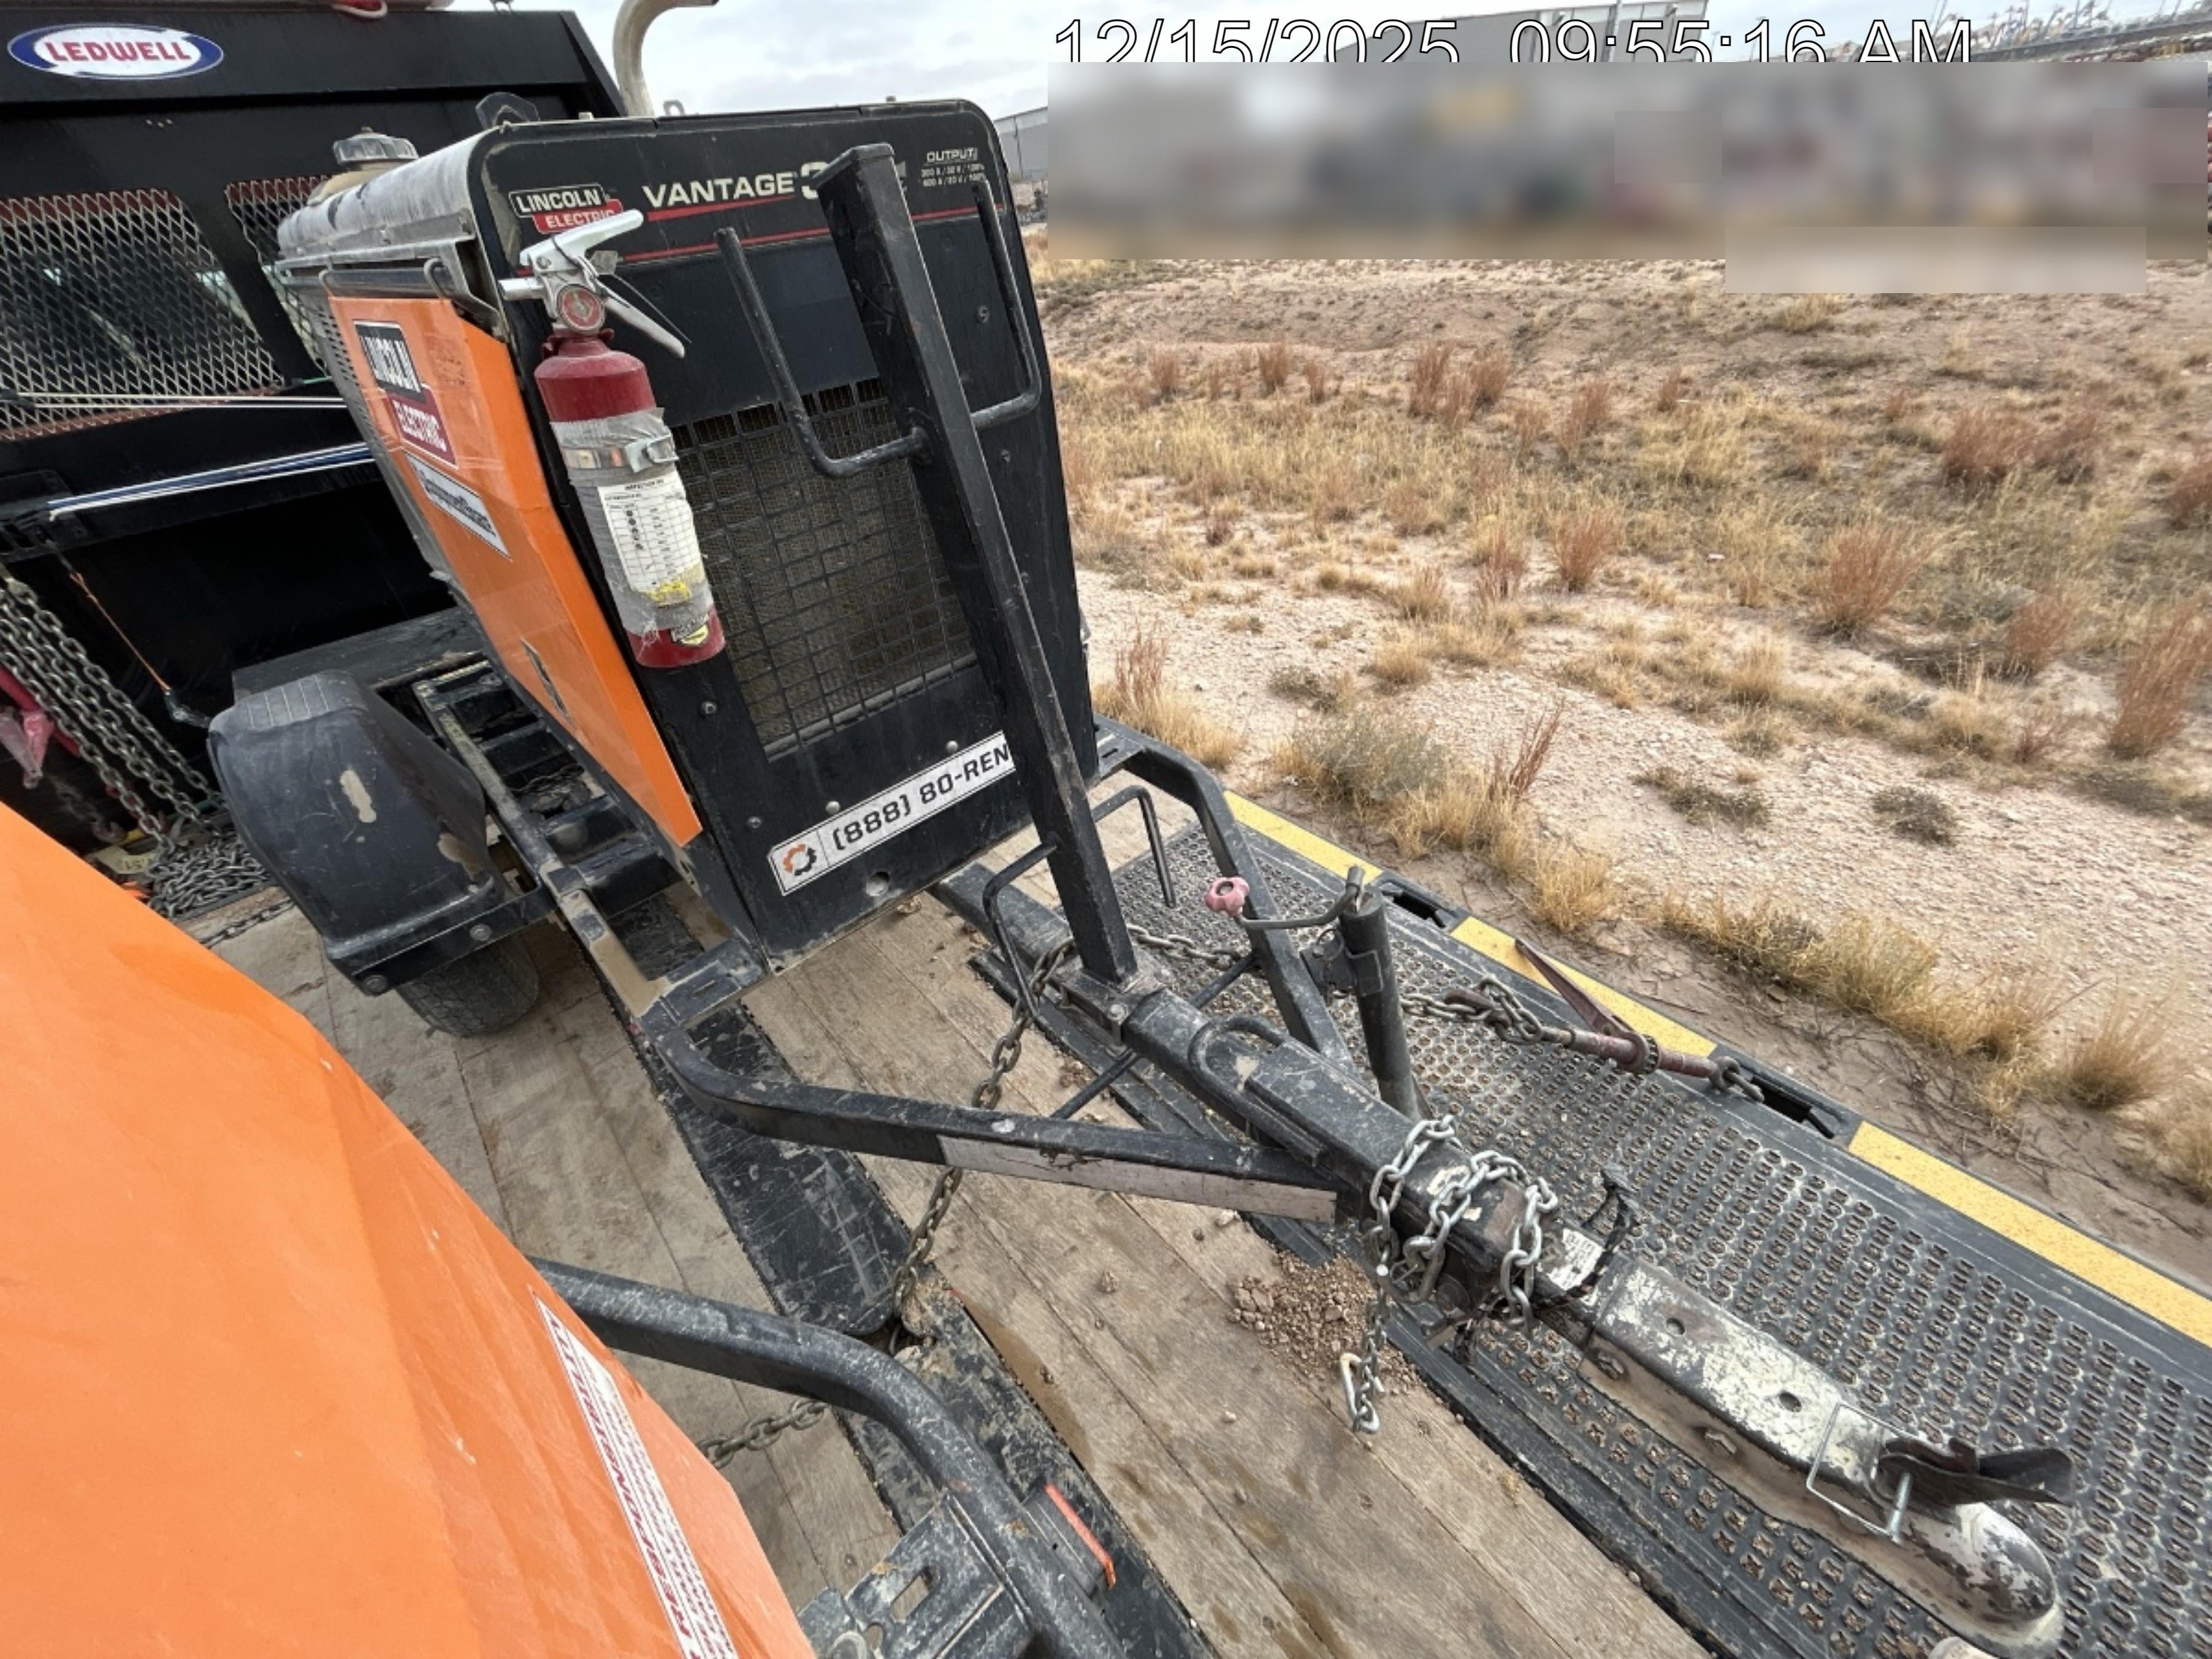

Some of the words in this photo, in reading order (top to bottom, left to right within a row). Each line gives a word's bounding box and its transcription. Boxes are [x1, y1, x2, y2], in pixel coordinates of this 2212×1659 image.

[45, 41, 192, 61] LEDWELL
[516, 189, 602, 213] LINCOLN
[642, 171, 795, 208] VANTAGE
[833, 794, 911, 850] (888)
